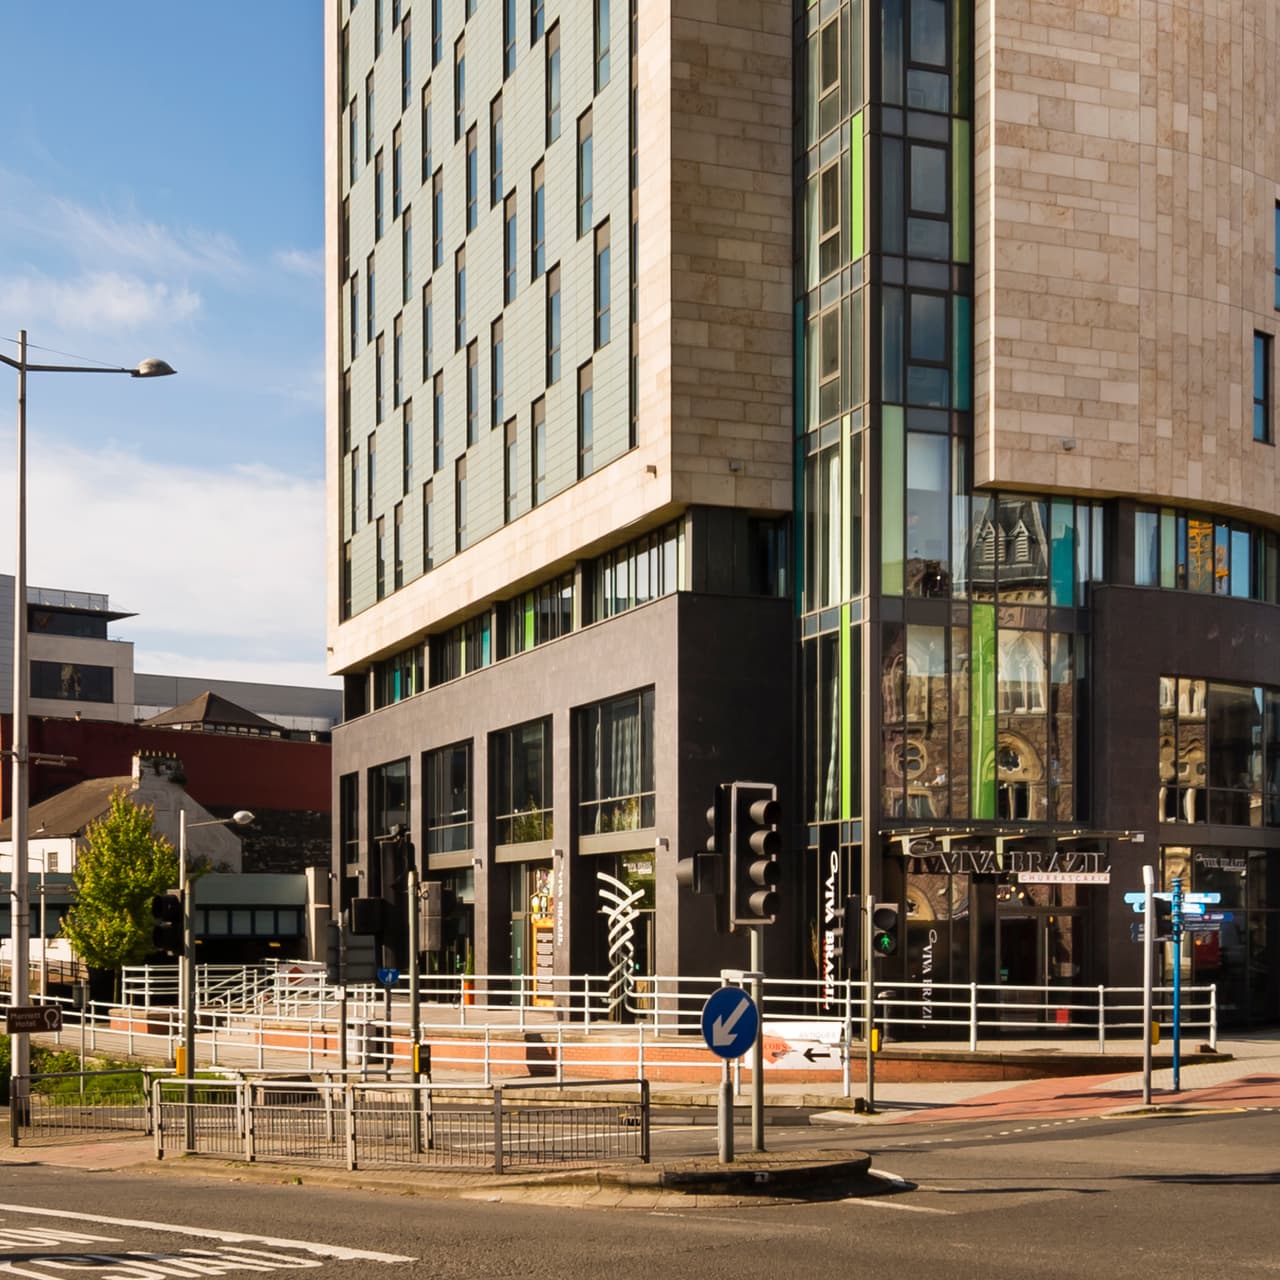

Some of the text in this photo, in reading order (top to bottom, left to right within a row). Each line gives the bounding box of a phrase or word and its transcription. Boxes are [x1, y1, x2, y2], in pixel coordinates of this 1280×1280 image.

[940, 851, 1112, 873] VIVA BRAZIL
[825, 877, 835, 1010] VIVA BRAZIL
[922, 945, 932, 974] VIVA
